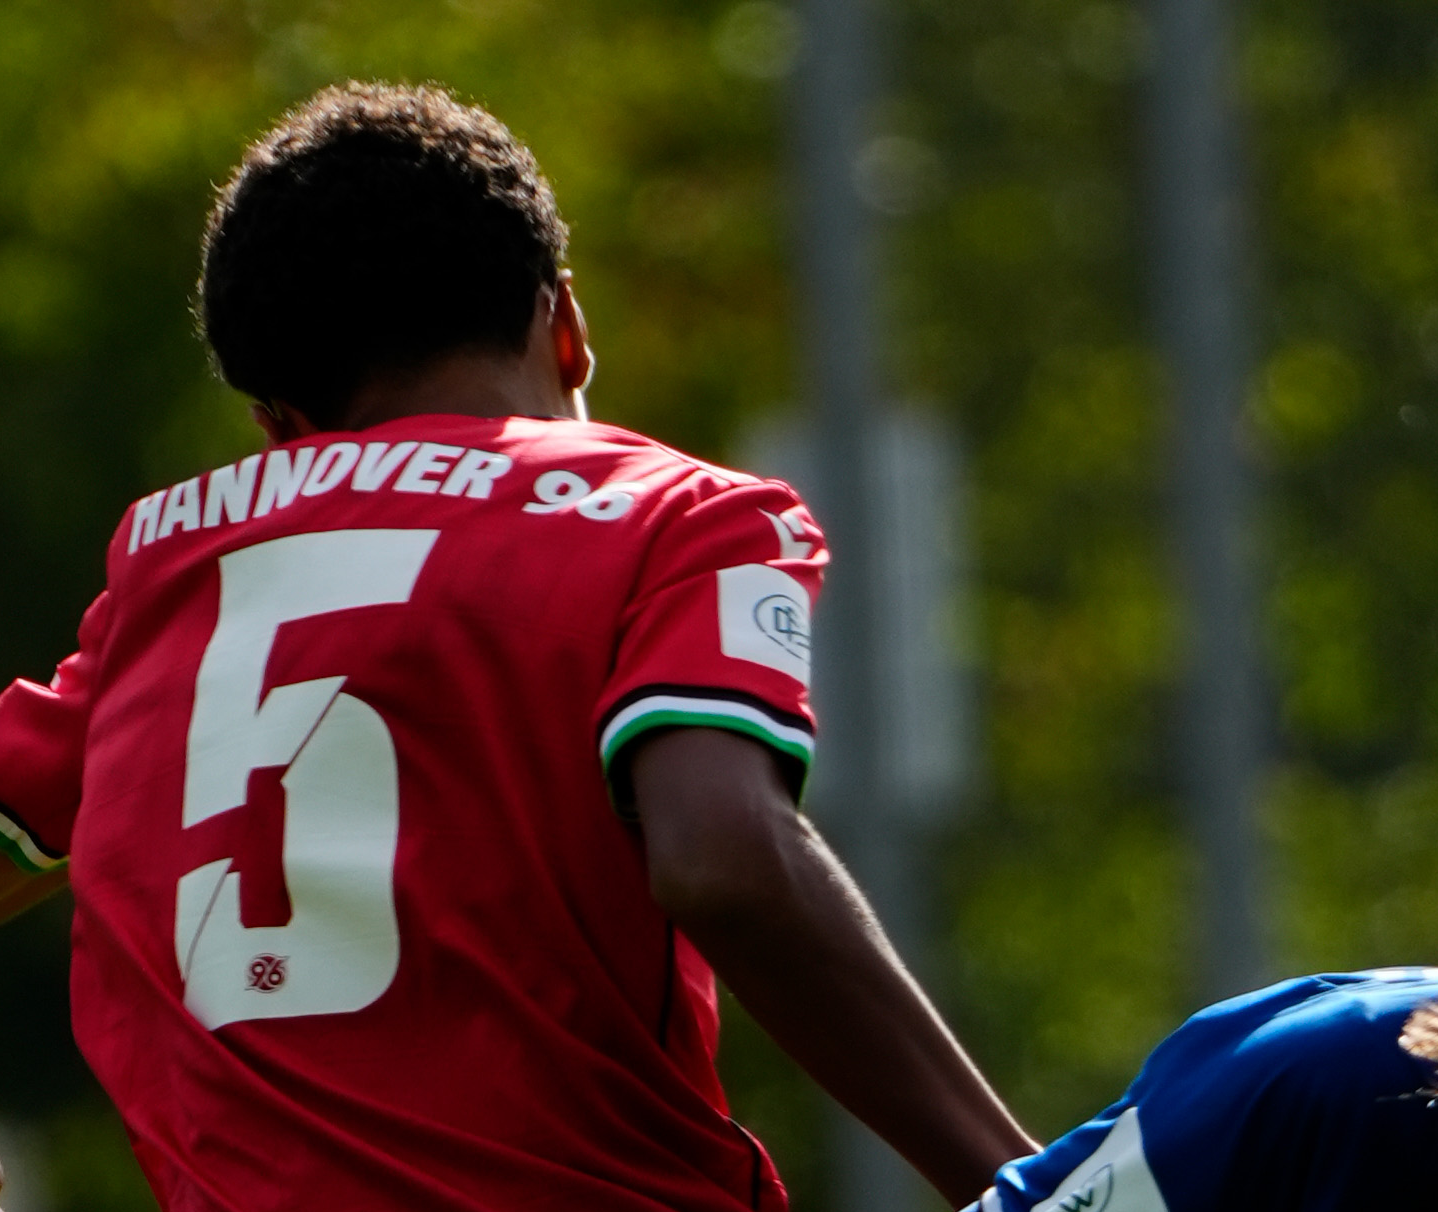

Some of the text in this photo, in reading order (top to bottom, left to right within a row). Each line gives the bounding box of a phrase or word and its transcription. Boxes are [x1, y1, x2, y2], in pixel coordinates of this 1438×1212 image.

[127, 442, 638, 556] HANNOVER 96
[175, 528, 441, 1031] 5
[247, 955, 288, 991] 96
